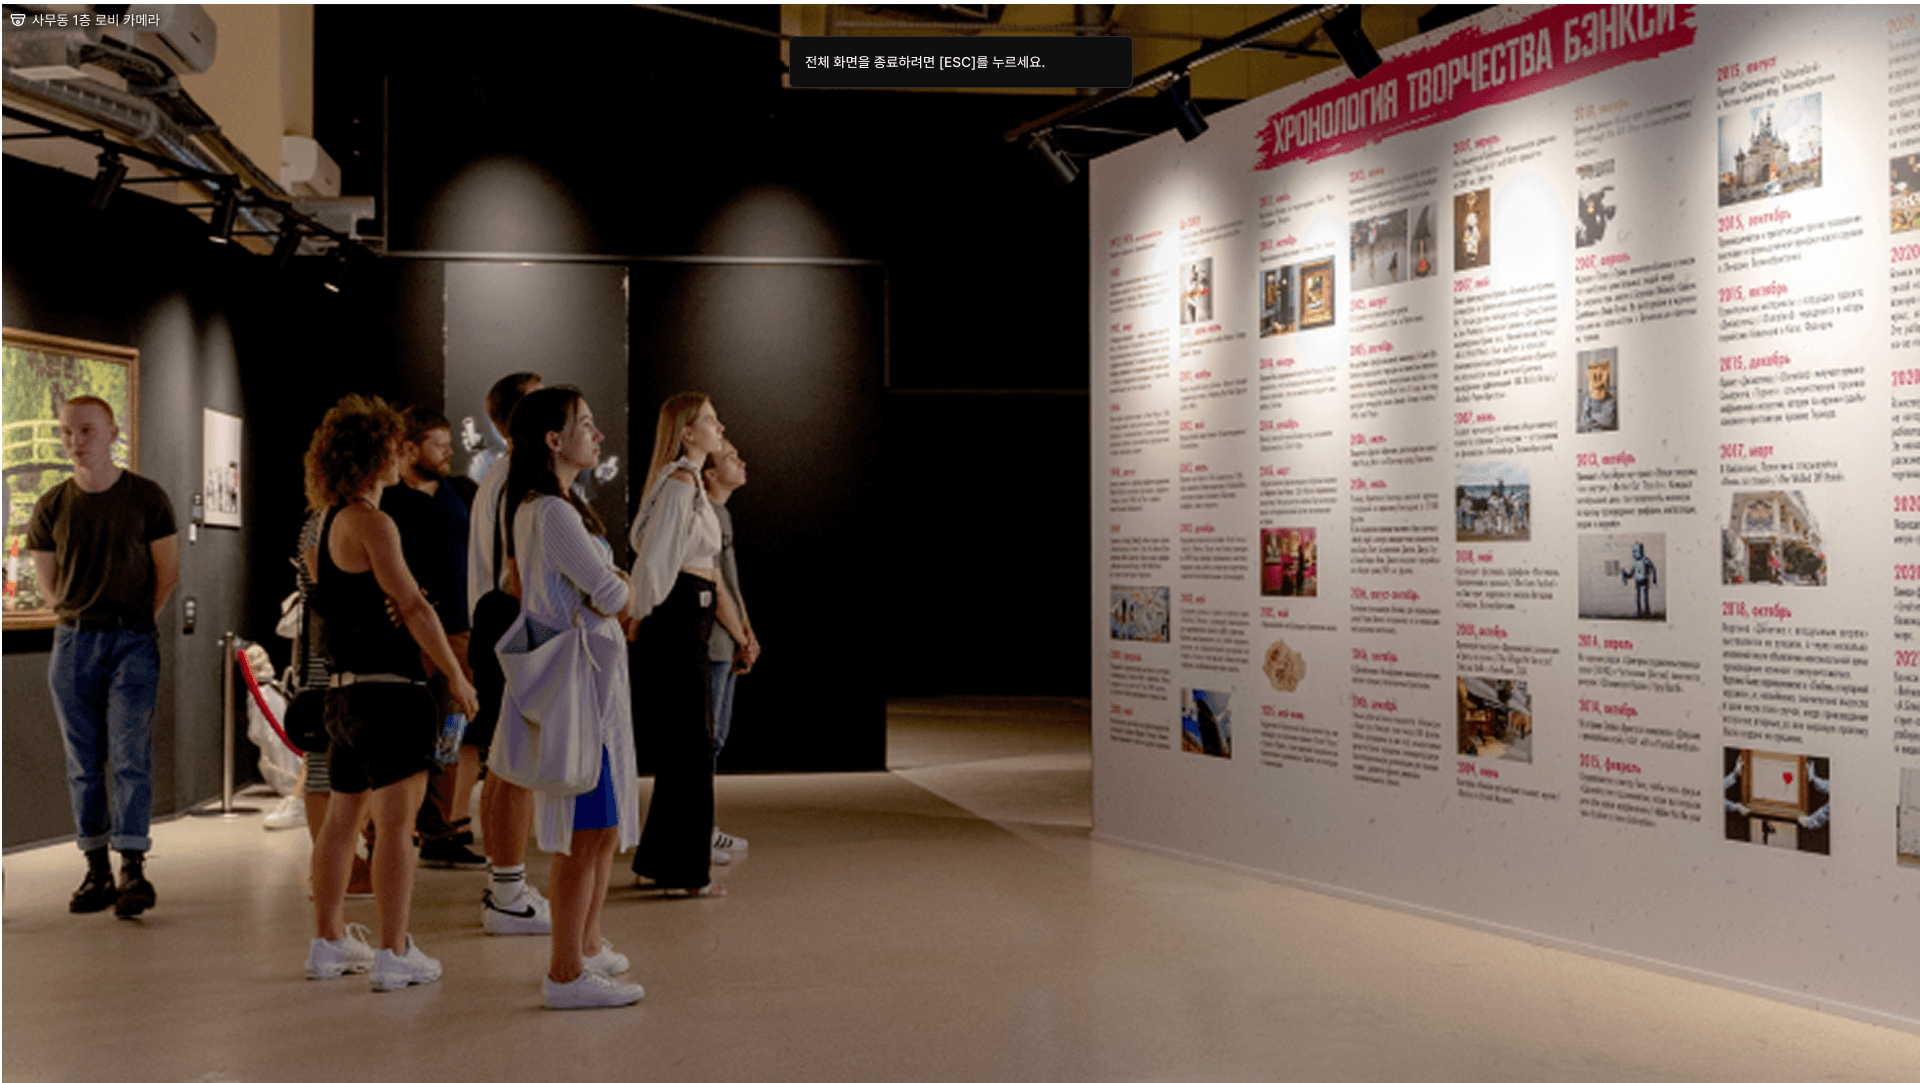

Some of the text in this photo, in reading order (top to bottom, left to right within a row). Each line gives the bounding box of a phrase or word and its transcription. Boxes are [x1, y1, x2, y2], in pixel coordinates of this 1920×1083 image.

[1272, 3, 1676, 155] ХРОНОЛОГИЯ ТВОРЧЕСТВА БЭНКСИ
